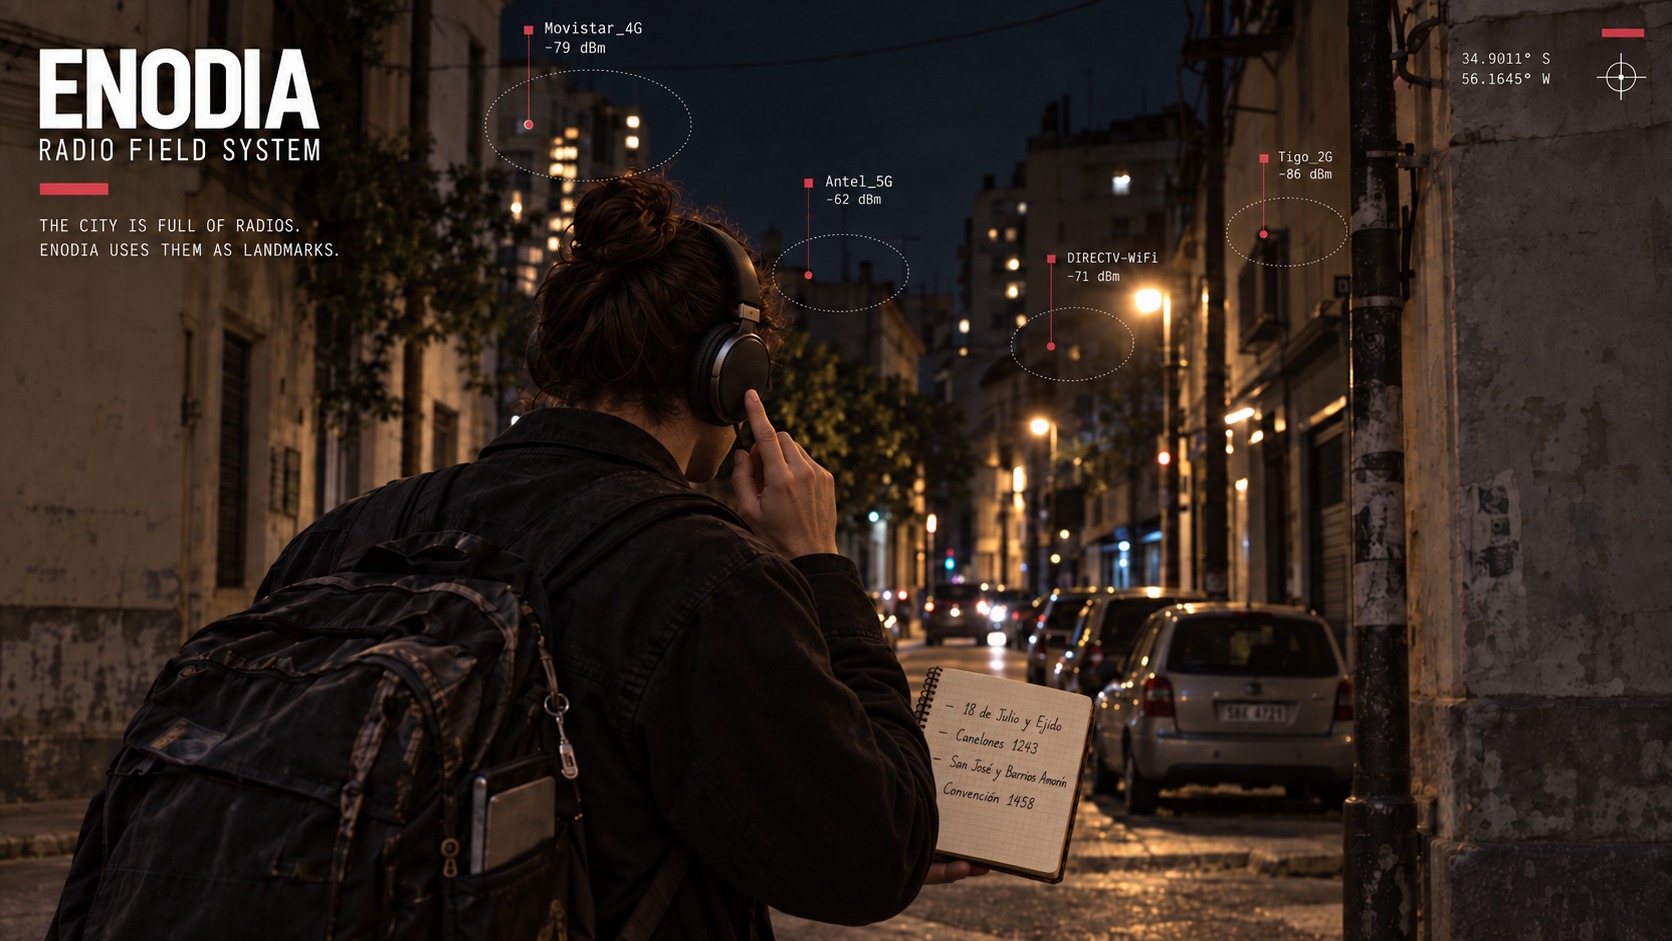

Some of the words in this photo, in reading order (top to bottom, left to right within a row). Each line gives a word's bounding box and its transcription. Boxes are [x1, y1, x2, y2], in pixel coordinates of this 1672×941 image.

[963, 702, 976, 716] 18
[979, 705, 992, 719] de
[995, 708, 1020, 723] Julio
[1021, 719, 1031, 731] y
[1036, 715, 1062, 734] Ejido
[956, 728, 1005, 749] Canelones
[1011, 739, 1039, 754] 1243
[949, 755, 968, 770] San
[971, 759, 993, 775] José
[992, 769, 1002, 781] y
[1005, 764, 1036, 782] Barrios
[943, 782, 1000, 804] Convención
[1006, 794, 1035, 810] 1458
